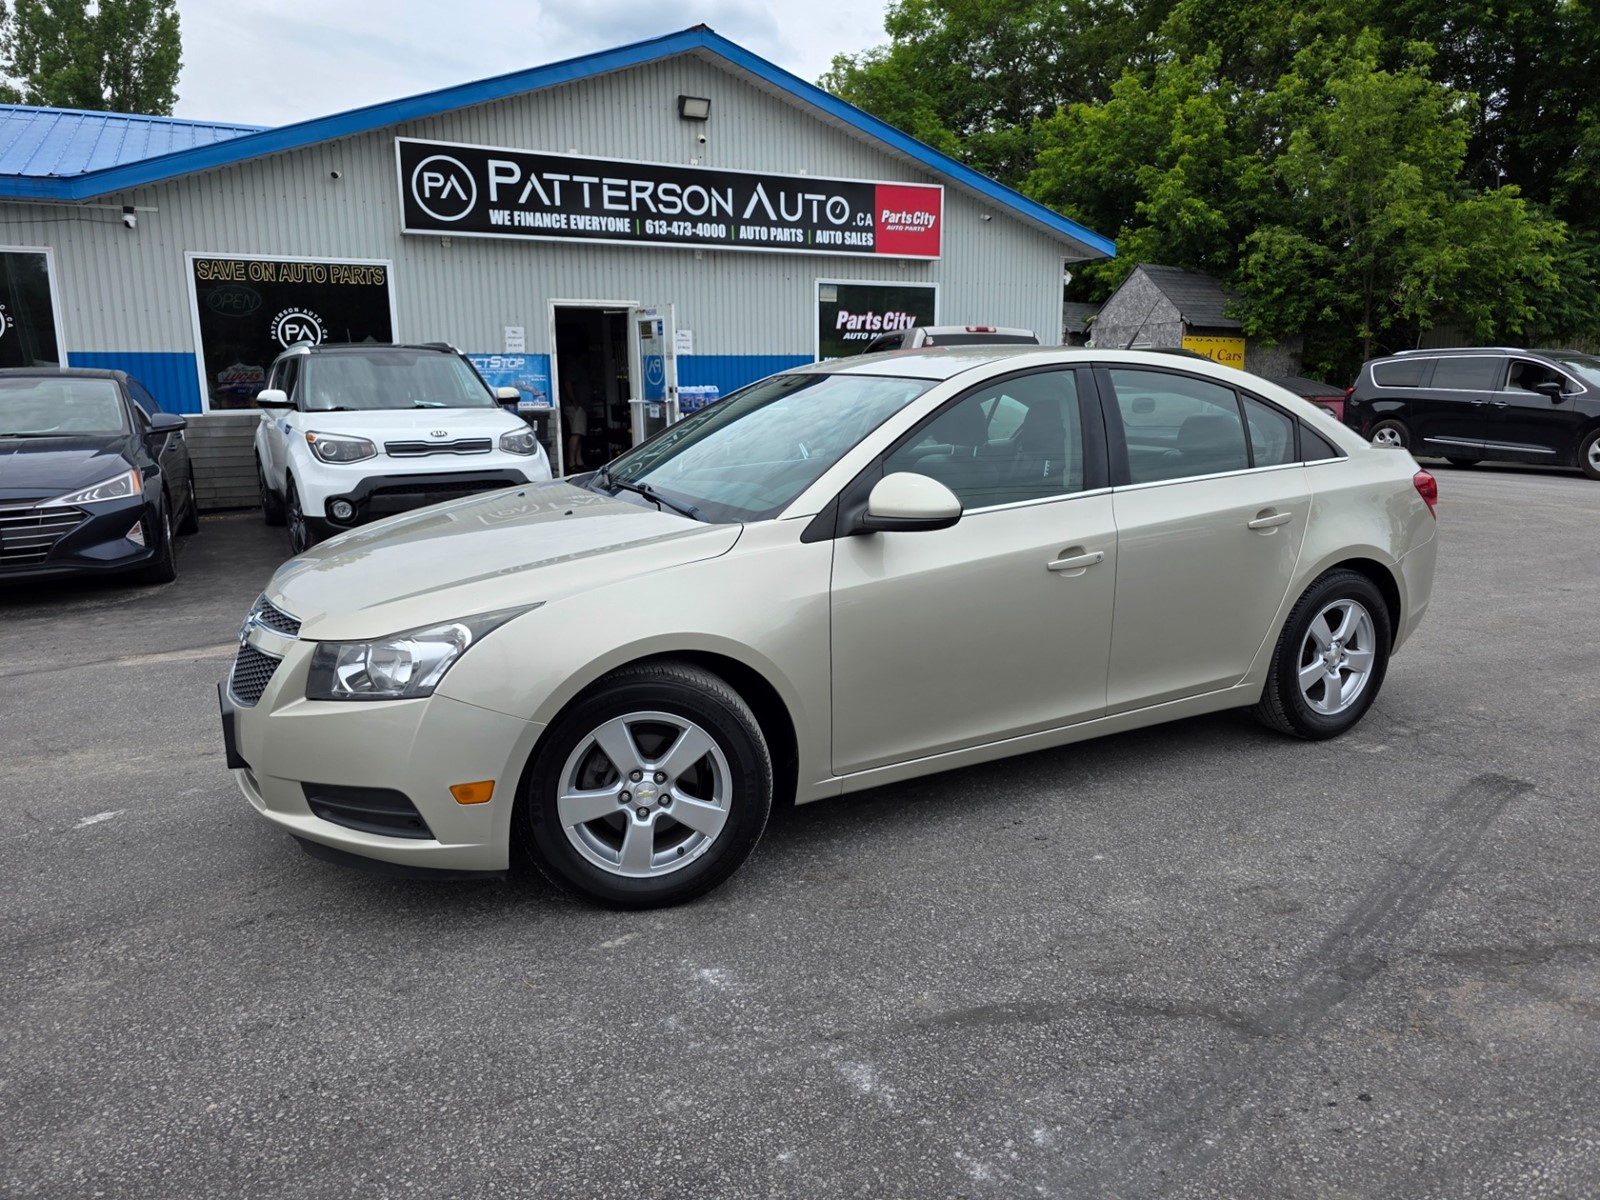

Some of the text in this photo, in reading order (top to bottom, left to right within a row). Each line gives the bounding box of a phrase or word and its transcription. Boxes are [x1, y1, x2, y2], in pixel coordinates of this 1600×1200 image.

[423, 171, 468, 201] PA
[487, 159, 733, 218] PATTERSON
[489, 209, 631, 233] WE FINANCE EVERYONE
[645, 219, 726, 239] 613-473-4000
[739, 225, 804, 242] AUTO PARTS
[815, 229, 873, 246] AUTO SALES
[197, 260, 385, 285] SAVE ON AUTO PARTS
[210, 292, 256, 309] OPEN
[285, 324, 316, 341] PA
[843, 332, 868, 340] AUTO
[1217, 348, 1243, 361] Cars
